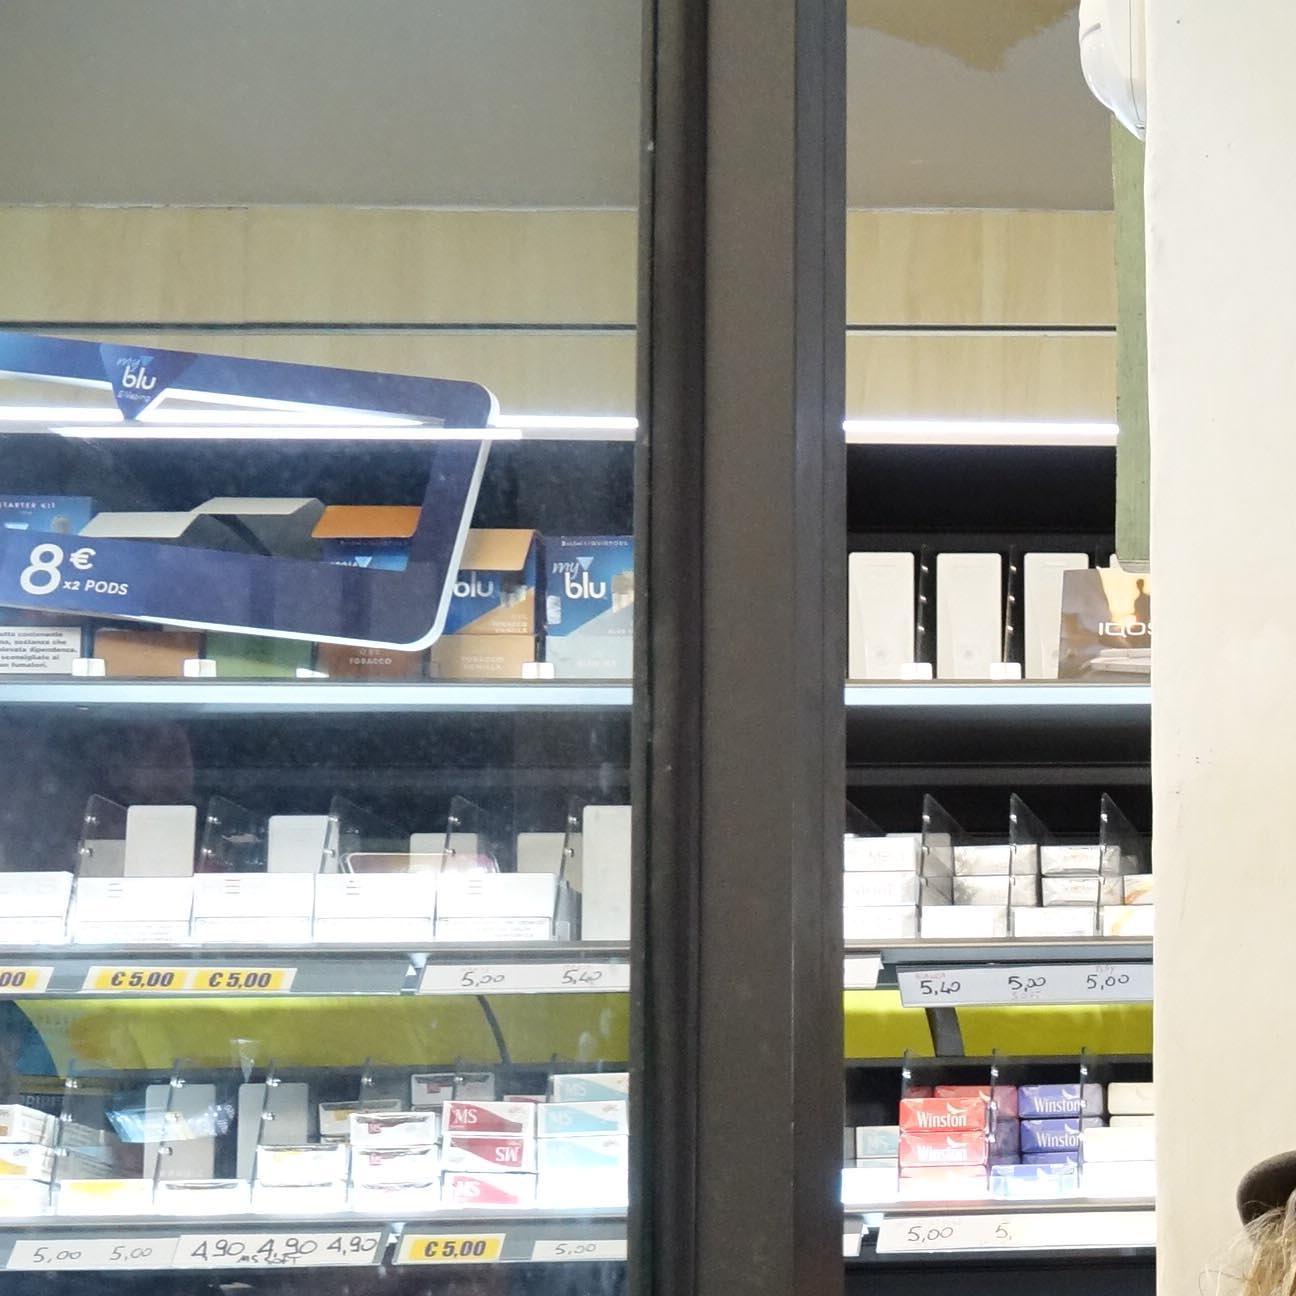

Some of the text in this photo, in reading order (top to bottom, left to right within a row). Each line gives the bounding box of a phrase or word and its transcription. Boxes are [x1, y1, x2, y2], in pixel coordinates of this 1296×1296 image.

[122, 366, 157, 390] blu
[20, 543, 96, 595] 8 €
[552, 560, 579, 579] my
[63, 580, 129, 595] x2 PODS
[565, 572, 606, 599] blu
[128, 972, 174, 987] 5,00
[226, 973, 271, 987] 5,00
[1035, 1096, 1081, 1113] Winston
[453, 1109, 478, 1124] MS
[917, 1111, 967, 1128] Winston
[496, 1147, 520, 1162] MS
[917, 1145, 967, 1161] Winston
[442, 1240, 487, 1258] 5,00
